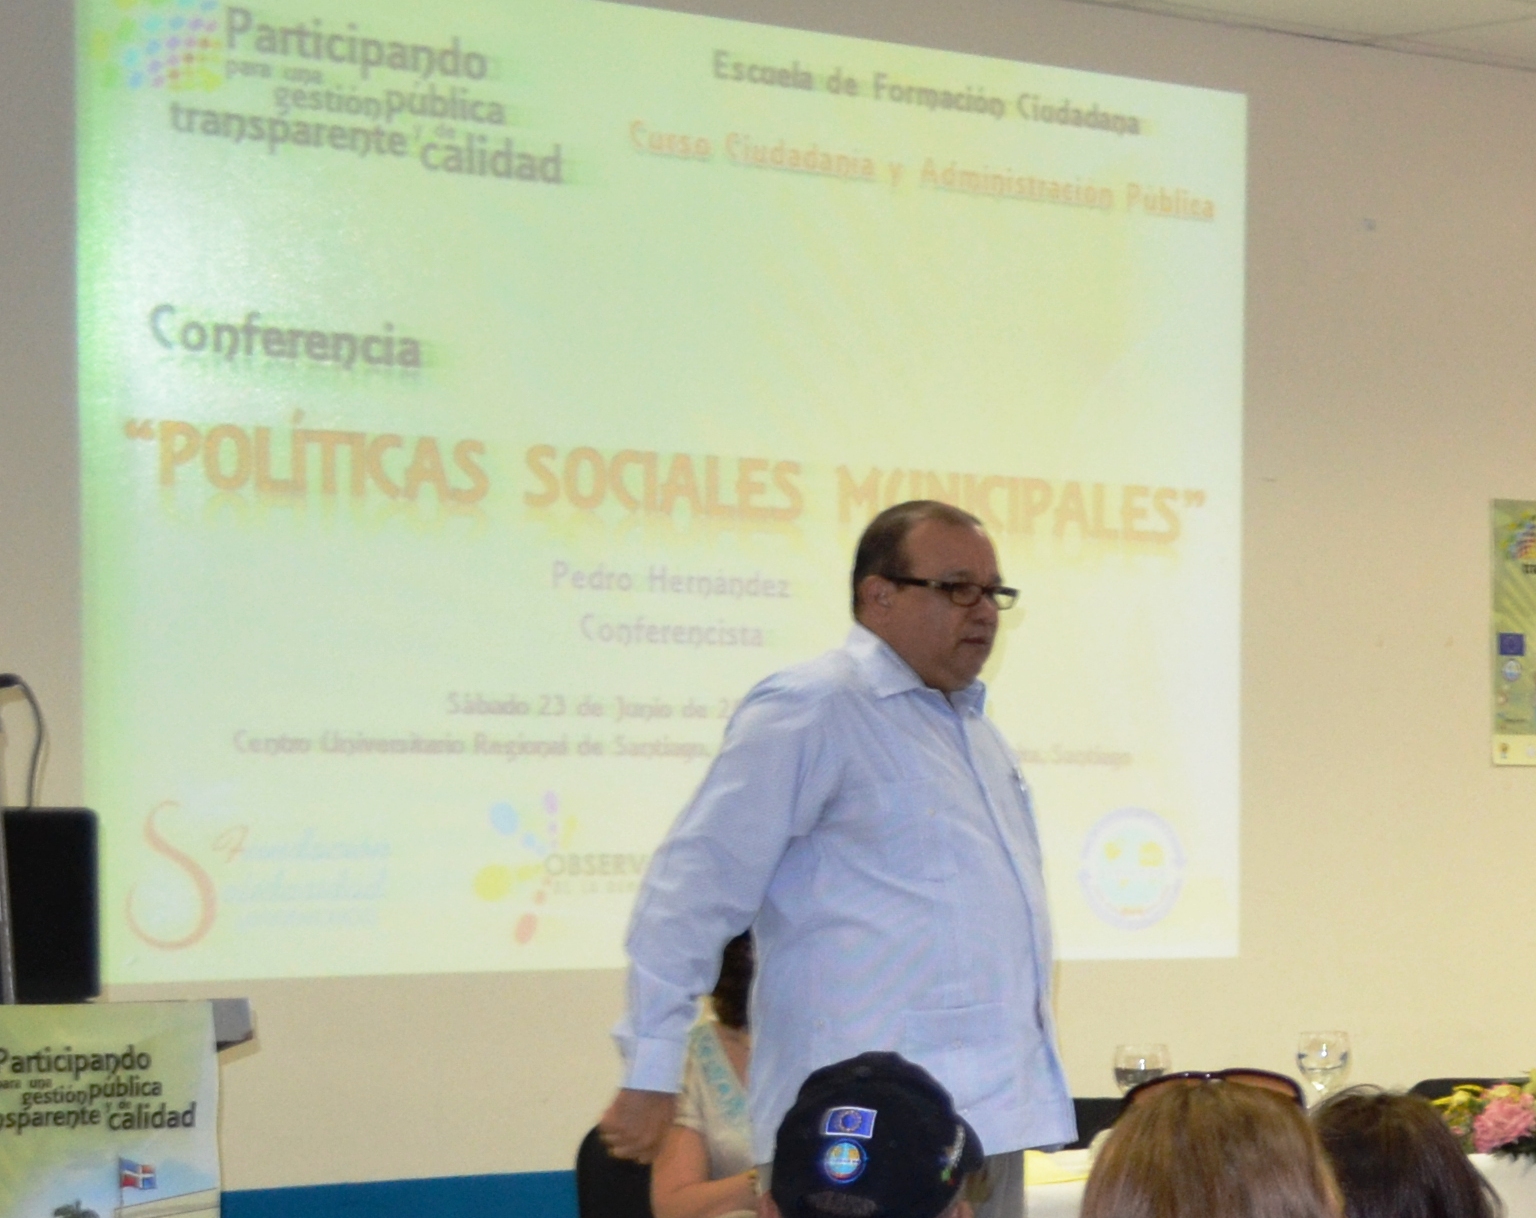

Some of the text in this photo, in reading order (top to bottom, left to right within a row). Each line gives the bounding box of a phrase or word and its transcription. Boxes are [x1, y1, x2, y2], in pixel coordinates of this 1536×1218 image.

[224, 6, 488, 80] Participando
[225, 58, 271, 80] para
[275, 80, 506, 126] gestión pública
[713, 49, 1141, 137] Escuela de Formación Ciudadana
[169, 101, 408, 158] transparente
[420, 134, 564, 185] calidad
[628, 119, 712, 160] Curso
[889, 162, 902, 187] y
[149, 303, 422, 371] Conferencia
[522, 443, 801, 522] SOCIALES
[550, 559, 793, 600] Pedro Hernández
[579, 611, 766, 649] Conferencista
[576, 695, 605, 718] de
[681, 697, 708, 719] de
[576, 737, 602, 757] de
[544, 852, 650, 877] OBSERV
[21, 1075, 164, 1111] gestión pública
[29, 1077, 53, 1091] una
[107, 1101, 197, 1131] calidad
